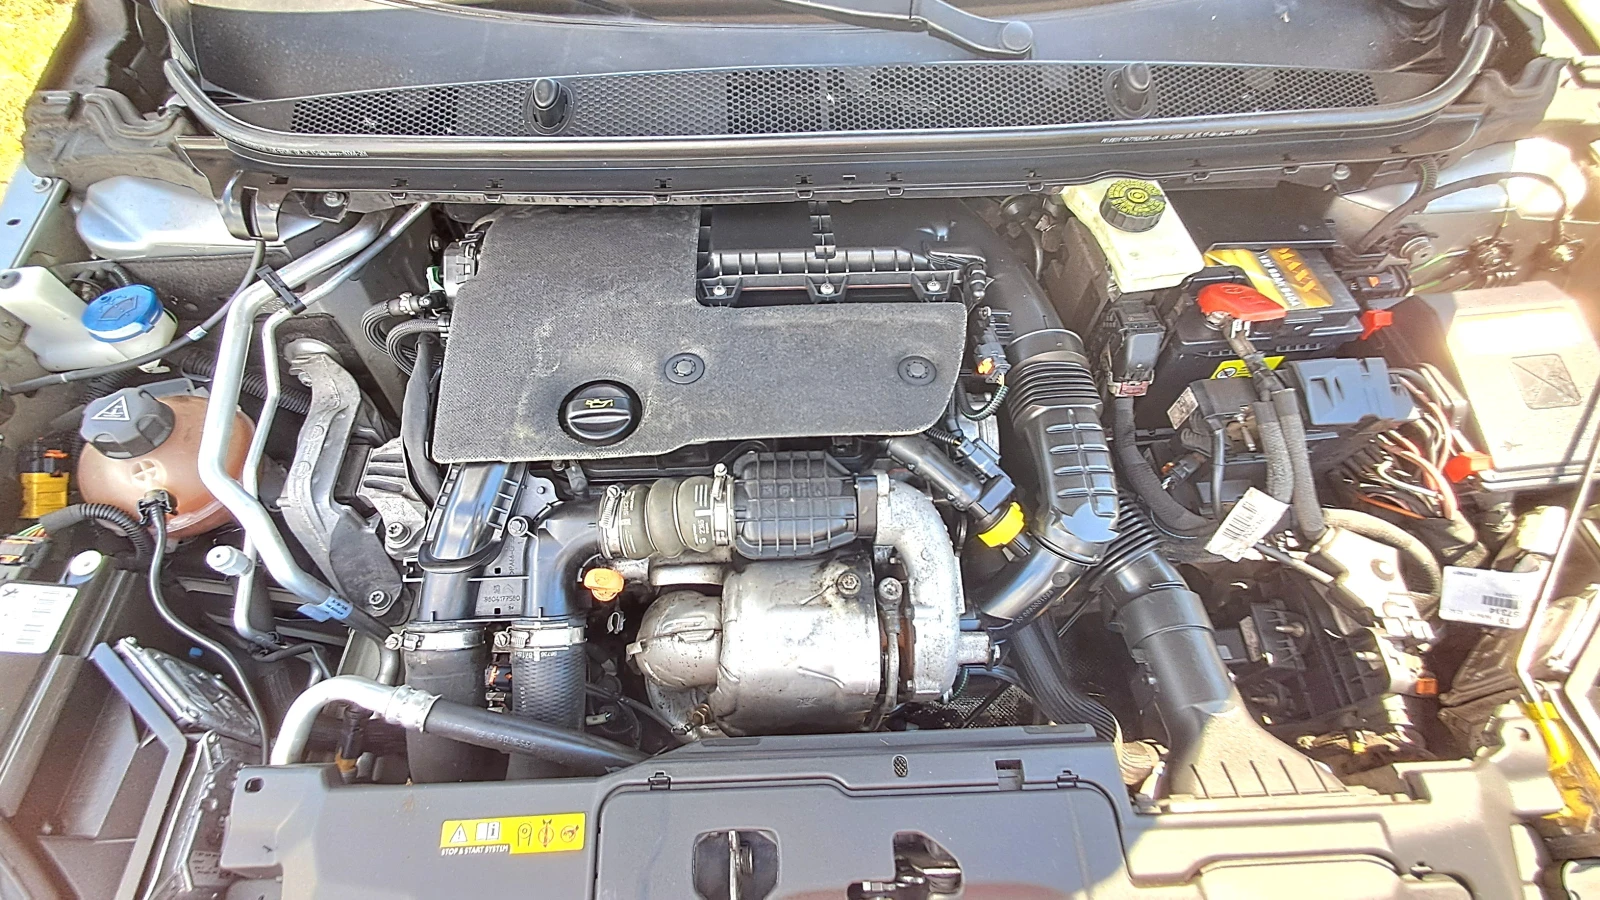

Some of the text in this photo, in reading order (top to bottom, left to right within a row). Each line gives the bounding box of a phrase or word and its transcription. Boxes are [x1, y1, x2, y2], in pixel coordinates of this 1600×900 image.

[441, 844, 509, 856] STOP & START SYSTEM
